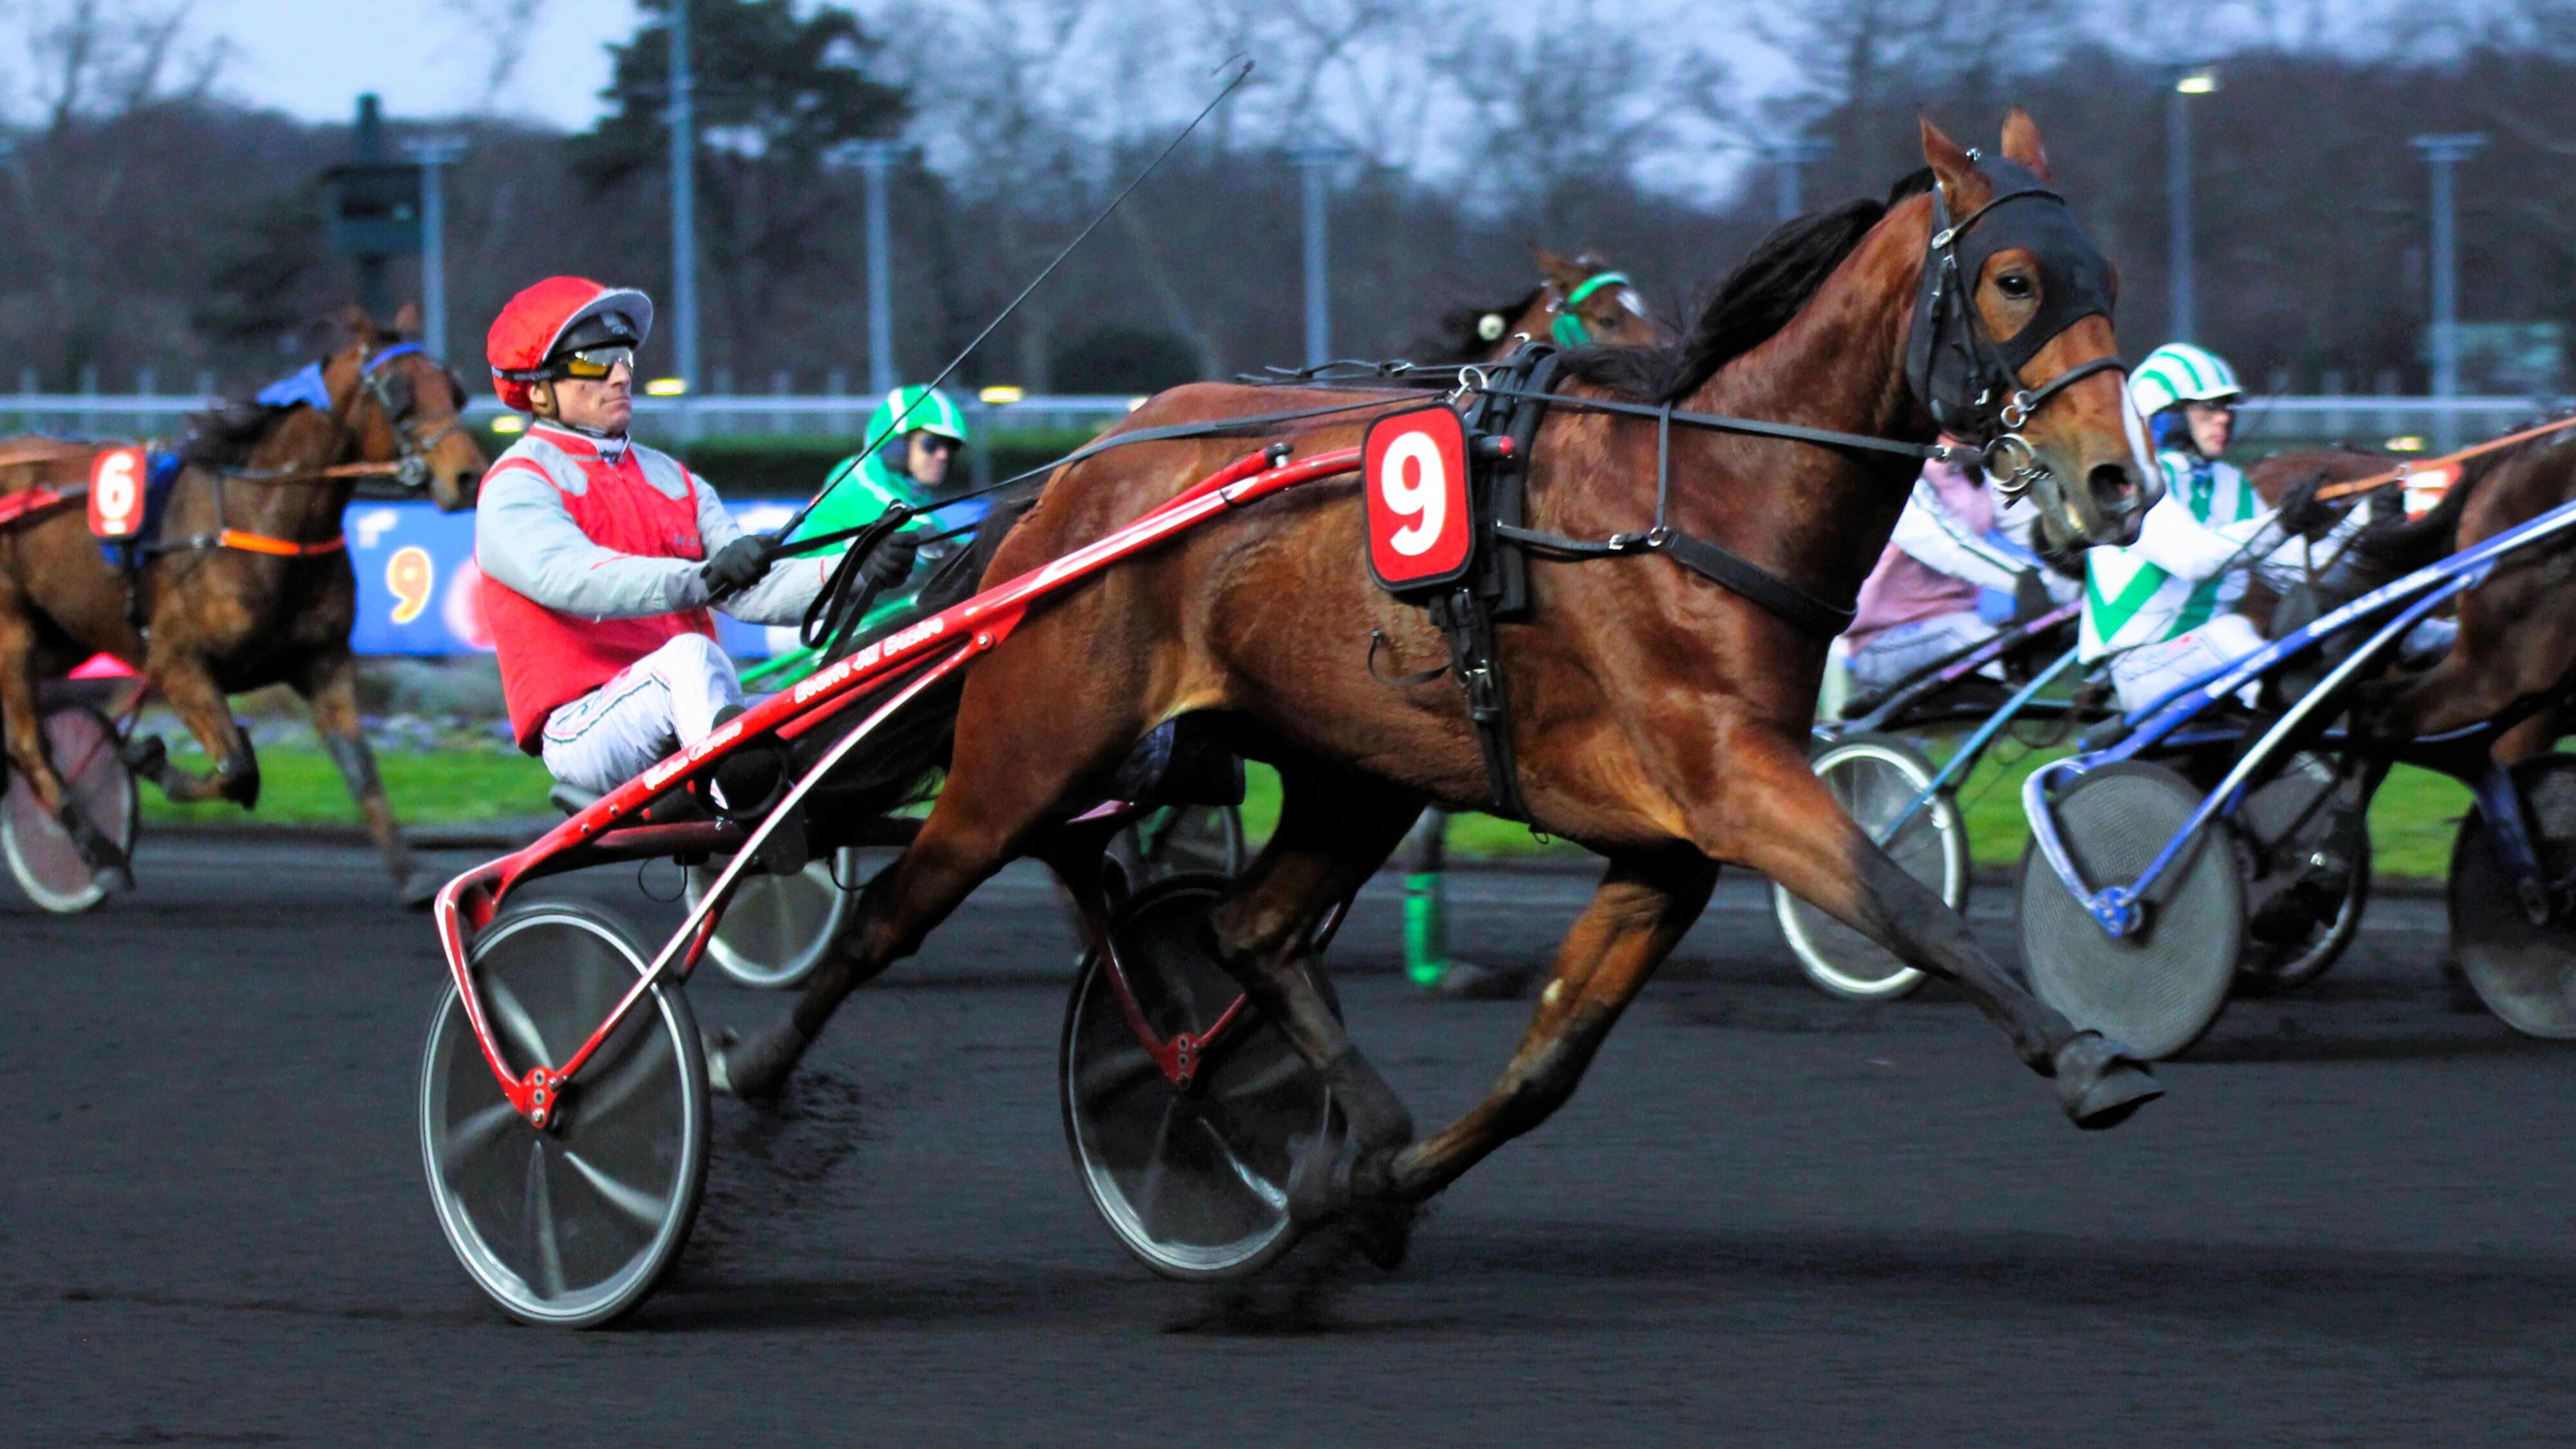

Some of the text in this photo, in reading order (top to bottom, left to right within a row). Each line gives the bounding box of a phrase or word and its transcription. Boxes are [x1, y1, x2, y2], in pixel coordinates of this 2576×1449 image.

[96, 451, 135, 519] 6
[1381, 431, 1447, 556] 9
[386, 546, 433, 624] 9
